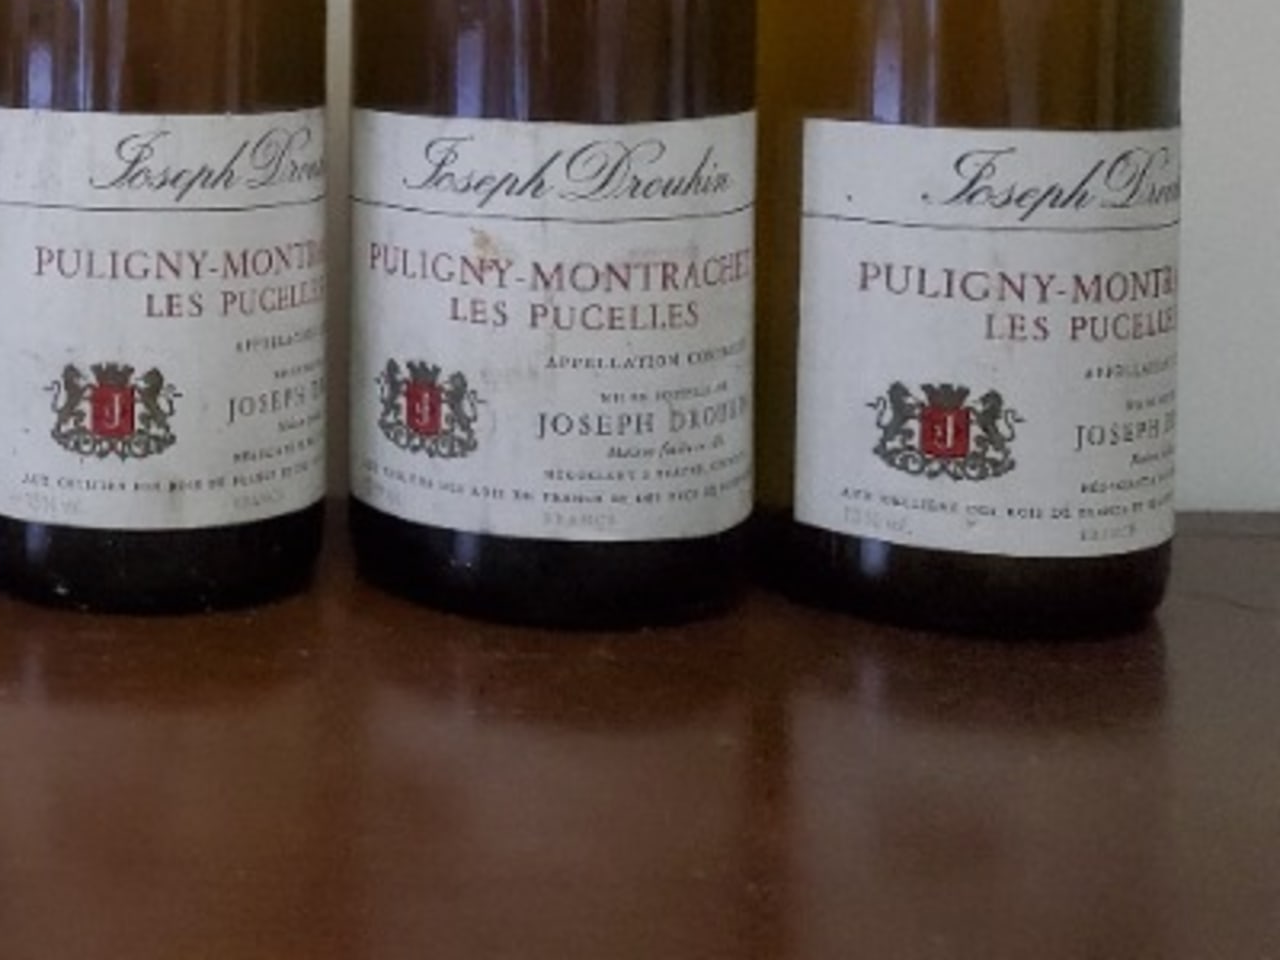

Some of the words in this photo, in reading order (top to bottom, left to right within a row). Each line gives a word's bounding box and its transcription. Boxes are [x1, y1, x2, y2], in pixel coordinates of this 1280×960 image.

[89, 129, 249, 203] Joseph
[402, 136, 565, 209] Joseph
[558, 140, 732, 201] Drouhin
[922, 146, 1106, 222] Joseph
[145, 292, 204, 318] LES
[450, 297, 509, 328] LES
[529, 300, 700, 332] PUCELLES
[985, 312, 1051, 342] LES
[545, 353, 681, 370] APPELLATION
[226, 385, 306, 428] JOSEPH
[537, 411, 655, 440] JOSEPH
[1074, 417, 1160, 453] JOSEPH
